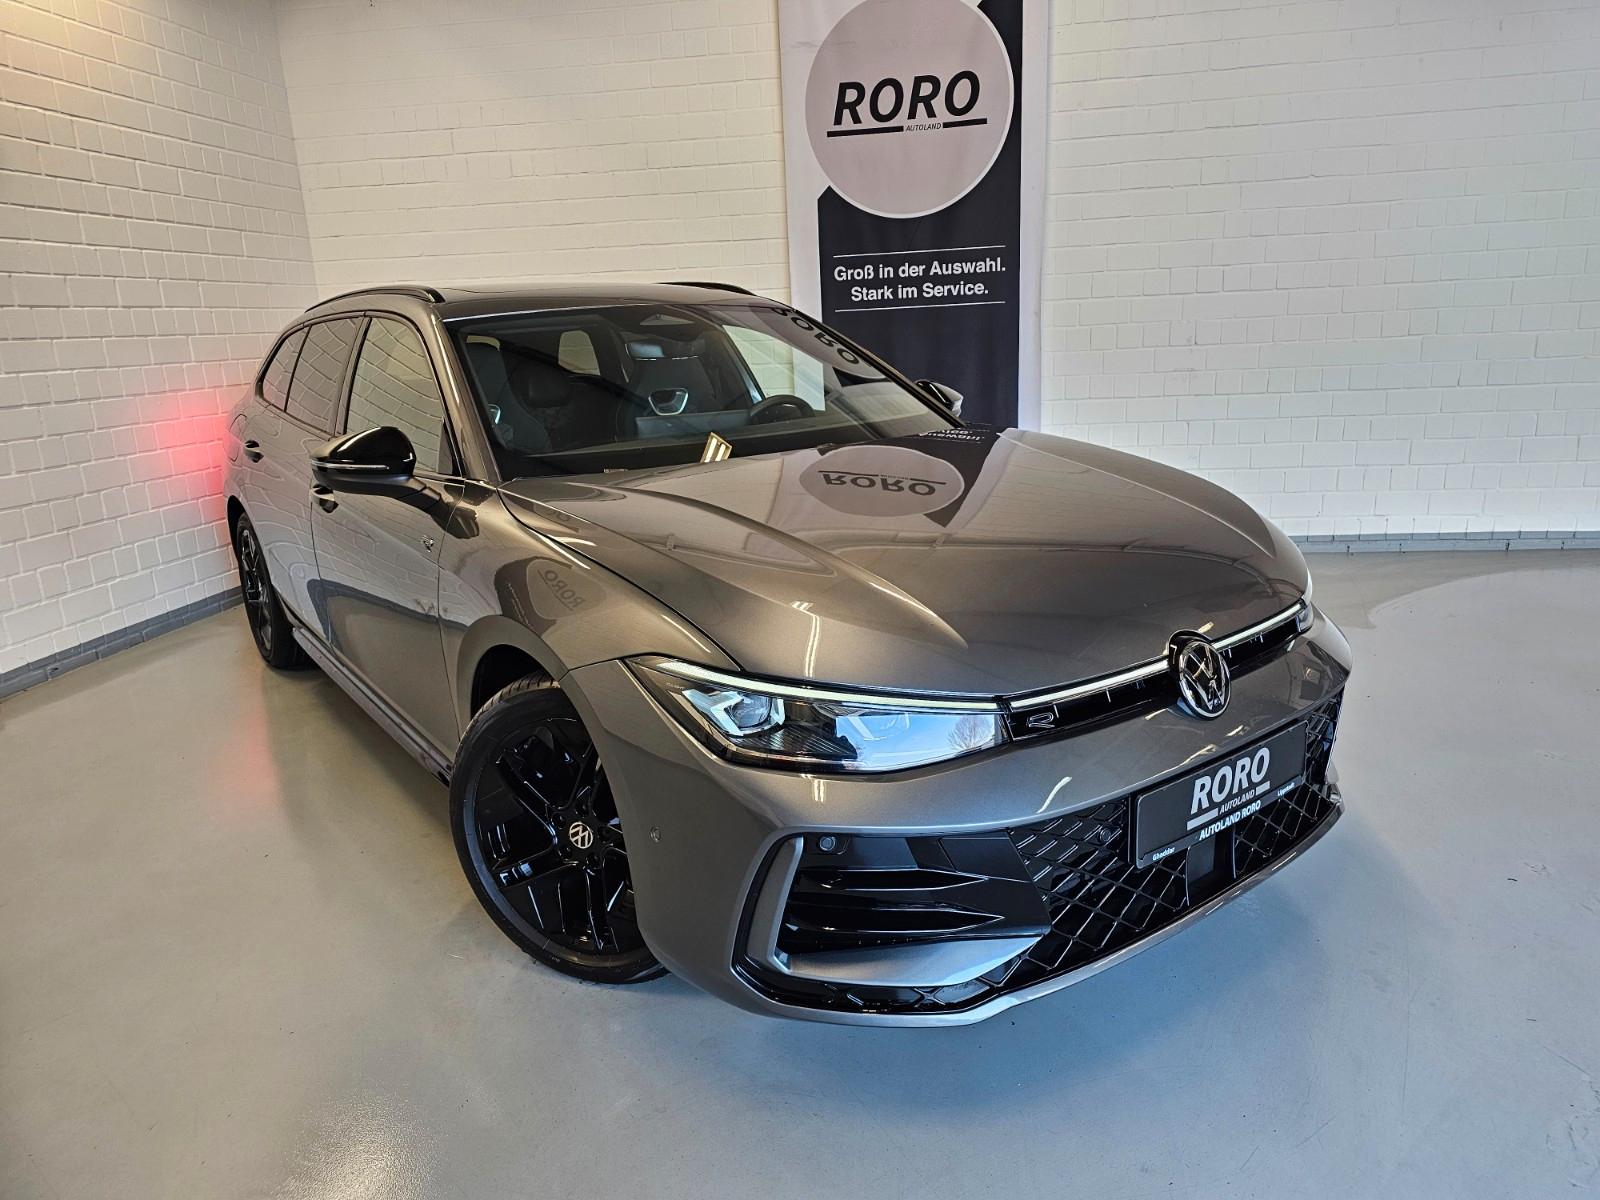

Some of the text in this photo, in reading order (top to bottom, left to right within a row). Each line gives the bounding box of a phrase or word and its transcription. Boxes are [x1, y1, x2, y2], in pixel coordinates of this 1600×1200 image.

[833, 70, 980, 126] RORO
[905, 122, 942, 132] AUTOLAND
[833, 257, 1006, 281] Groß in der Auswahl.
[850, 280, 989, 302] Stark im Service.
[1191, 747, 1270, 815] RORO
[1219, 789, 1255, 815] AUTOLAND
[1199, 800, 1262, 840] AUTOLAND RORO
